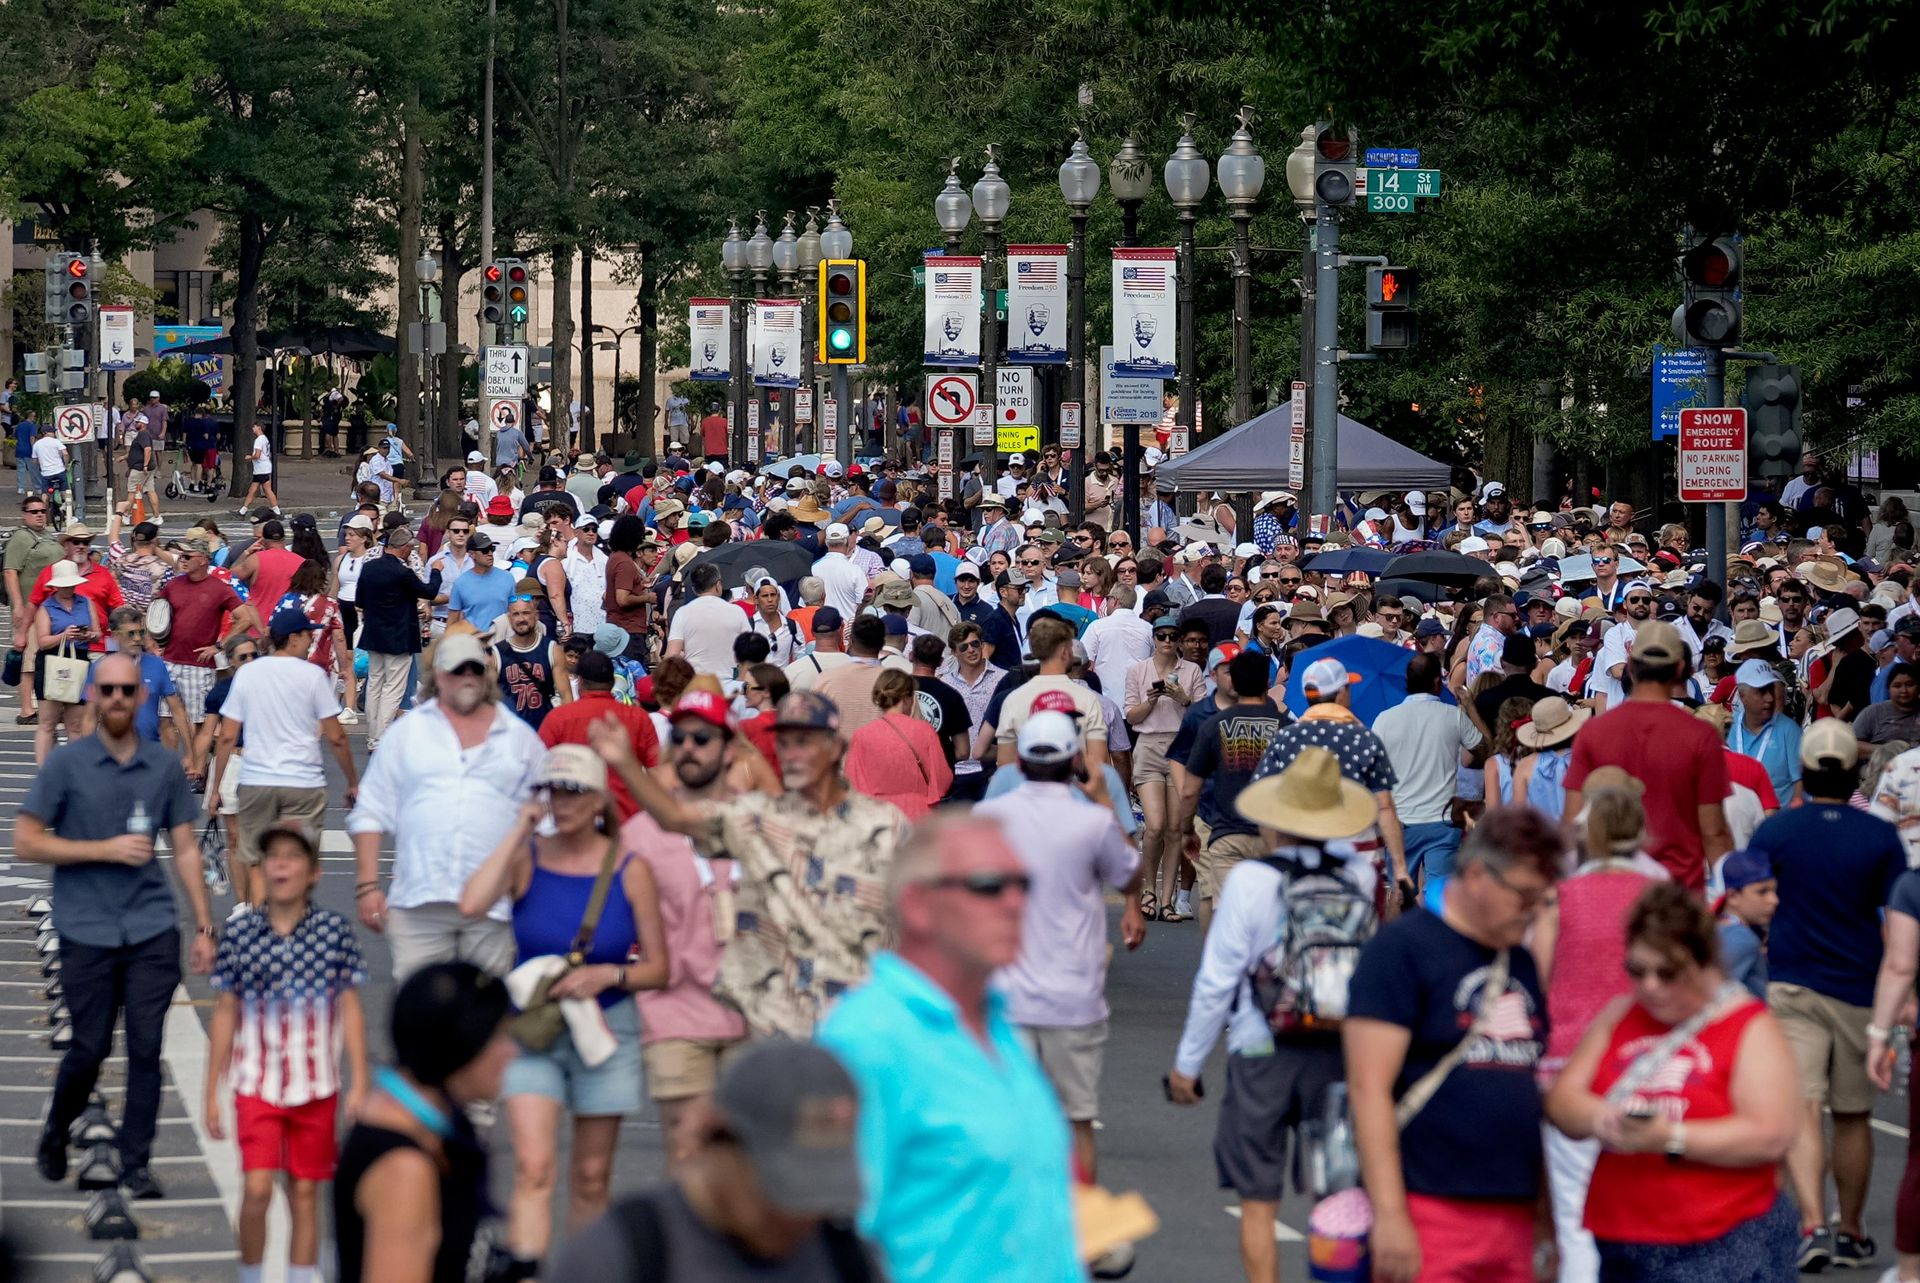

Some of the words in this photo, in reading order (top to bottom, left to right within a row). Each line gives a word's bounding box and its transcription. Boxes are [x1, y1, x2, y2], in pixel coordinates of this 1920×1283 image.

[1366, 152, 1398, 162] EVACUATION
[1400, 154, 1418, 164] ROUTE
[1378, 172, 1400, 192] 14
[1418, 173, 1431, 184] St
[1417, 184, 1432, 194] NW
[1373, 196, 1408, 210] 300
[1151, 292, 1166, 300] 250
[489, 350, 506, 358] THRU
[488, 376, 506, 384] OBEY
[510, 376, 524, 384] THIS
[1002, 372, 1020, 382] NO
[488, 386, 512, 394] SIGNAL
[999, 386, 1024, 394] TURN
[1010, 398, 1028, 406] RED
[1694, 414, 1732, 424] SNOW
[1686, 428, 1740, 436] EMERGENCY
[1694, 438, 1732, 448] ROUTE
[1687, 454, 1698, 463] NO
[1702, 454, 1740, 462] PARKING
[1696, 466, 1731, 475] DURING
[1686, 479, 1740, 488] EMERGENCY
[506, 662, 546, 684] USA
[511, 682, 542, 711] 76
[1220, 716, 1279, 740] VANS
